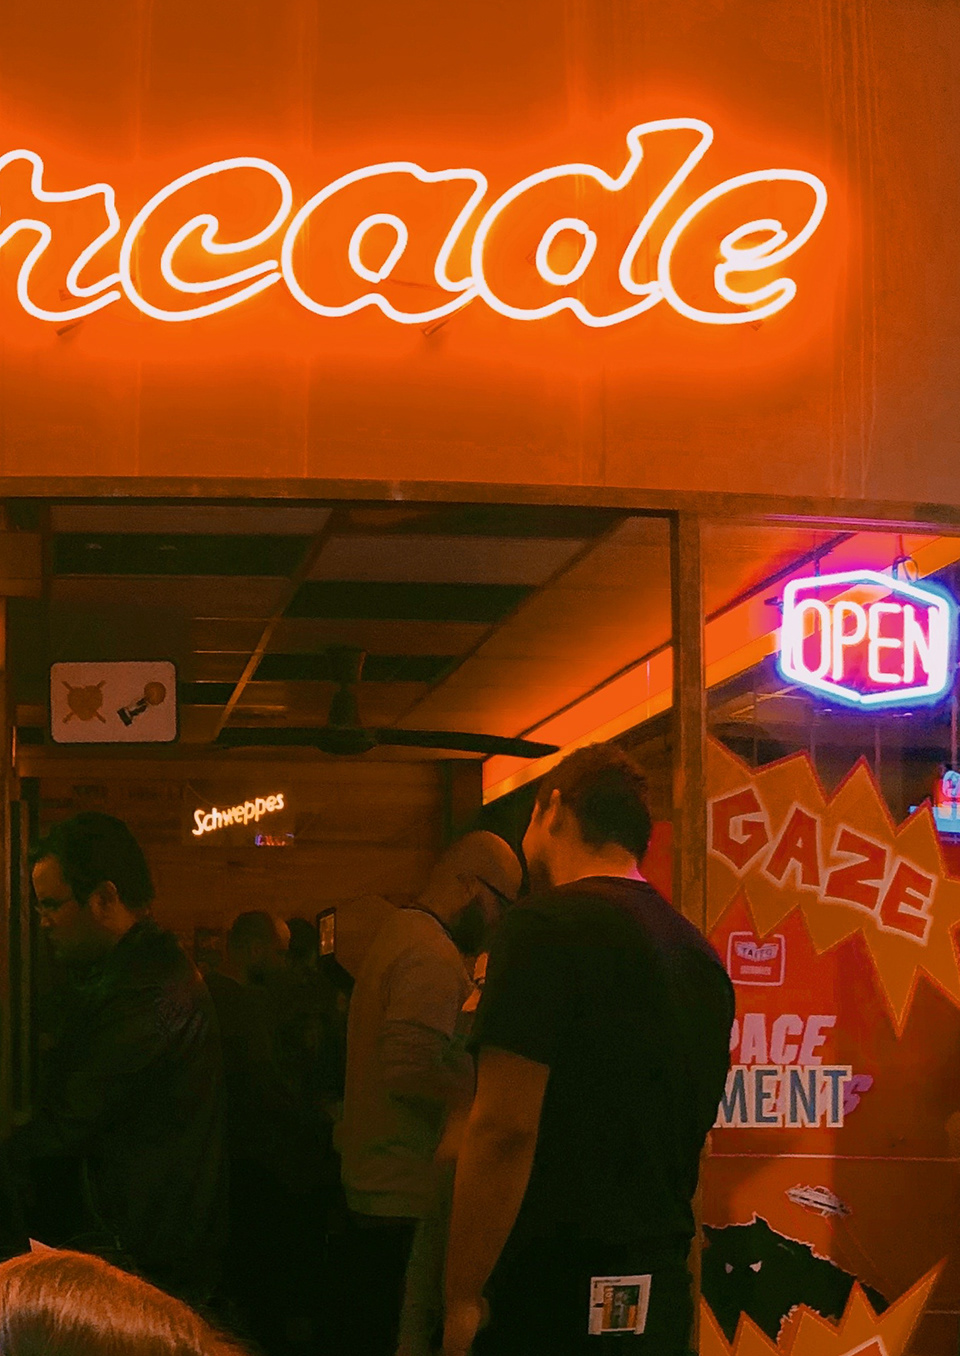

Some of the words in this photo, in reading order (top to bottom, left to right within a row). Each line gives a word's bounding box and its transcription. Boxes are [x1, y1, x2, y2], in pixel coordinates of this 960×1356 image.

[793, 599, 939, 684] OPEN
[192, 793, 284, 836] Schweppes
[706, 785, 937, 946] GAZE
